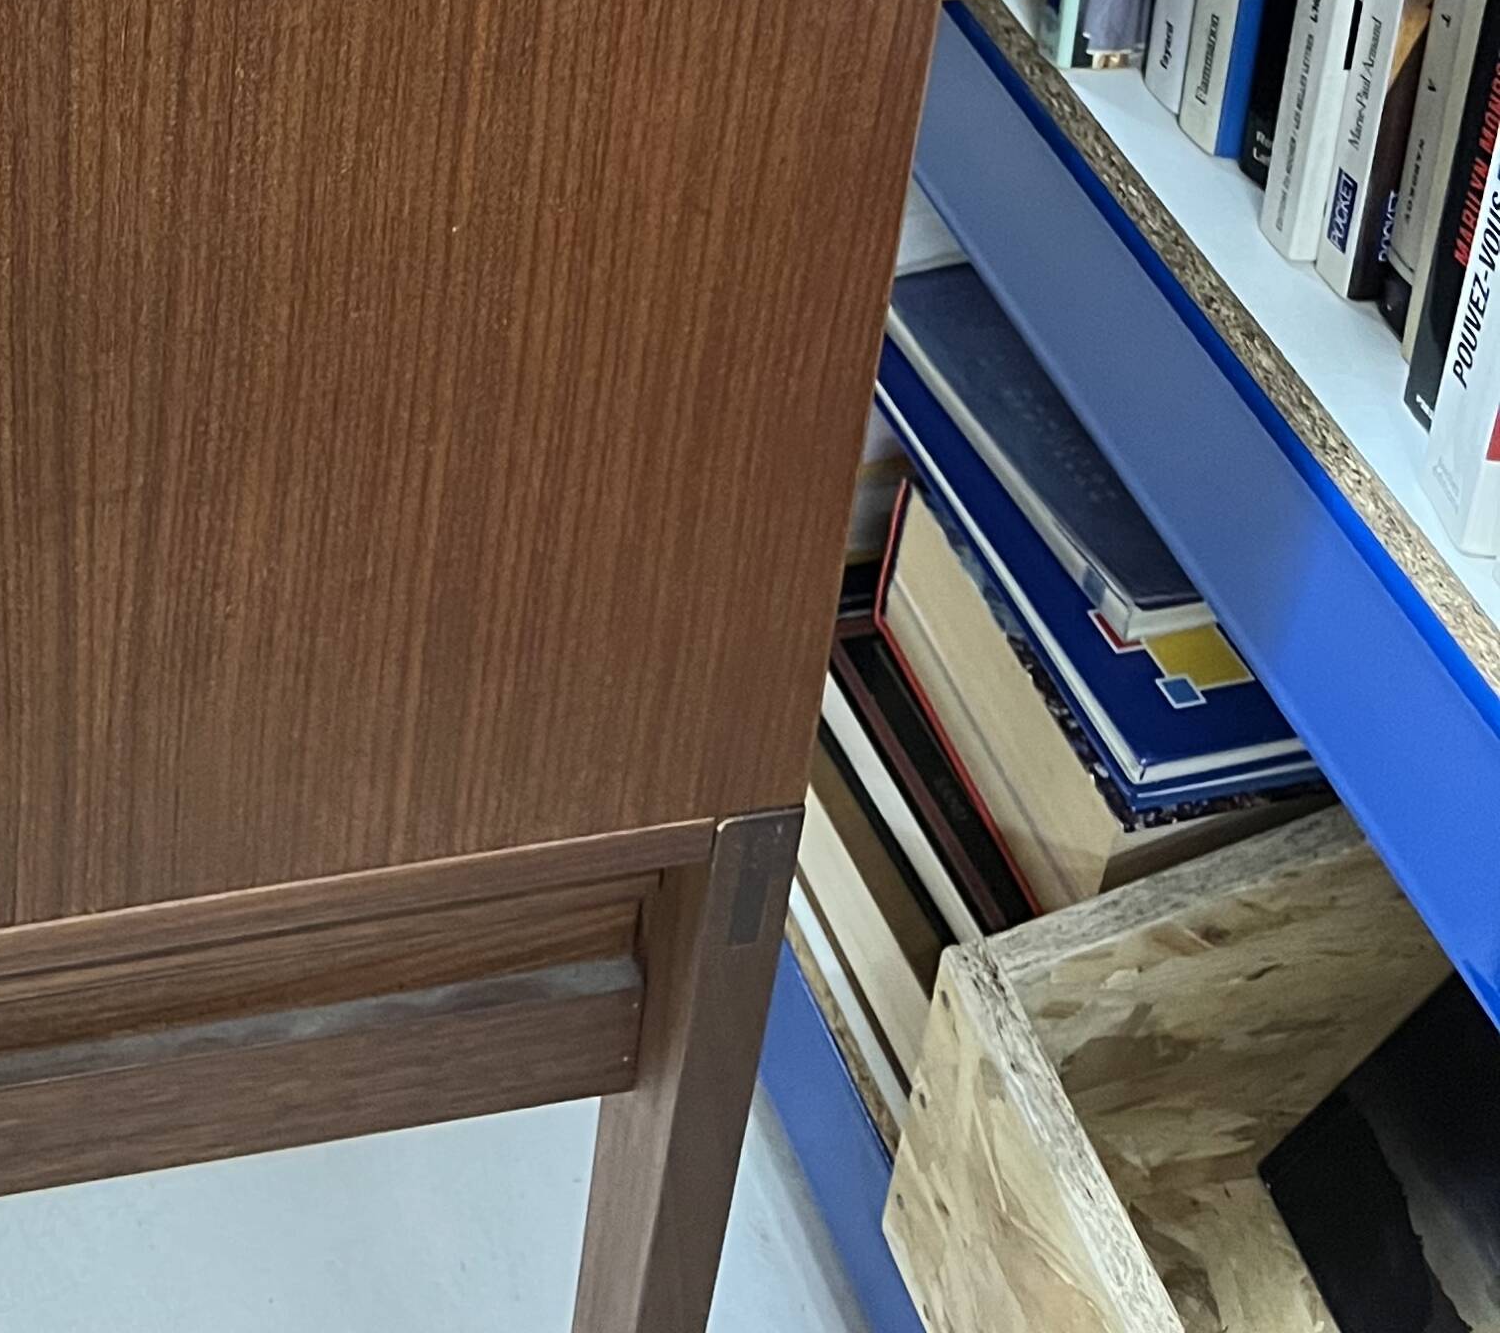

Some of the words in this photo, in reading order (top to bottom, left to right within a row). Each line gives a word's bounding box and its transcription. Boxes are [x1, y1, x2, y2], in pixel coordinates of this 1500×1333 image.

[1328, 173, 1357, 252] POCKET
[1453, 156, 1488, 269] MARILYN
[1452, 190, 1500, 391] POUVEZ-VOUS
